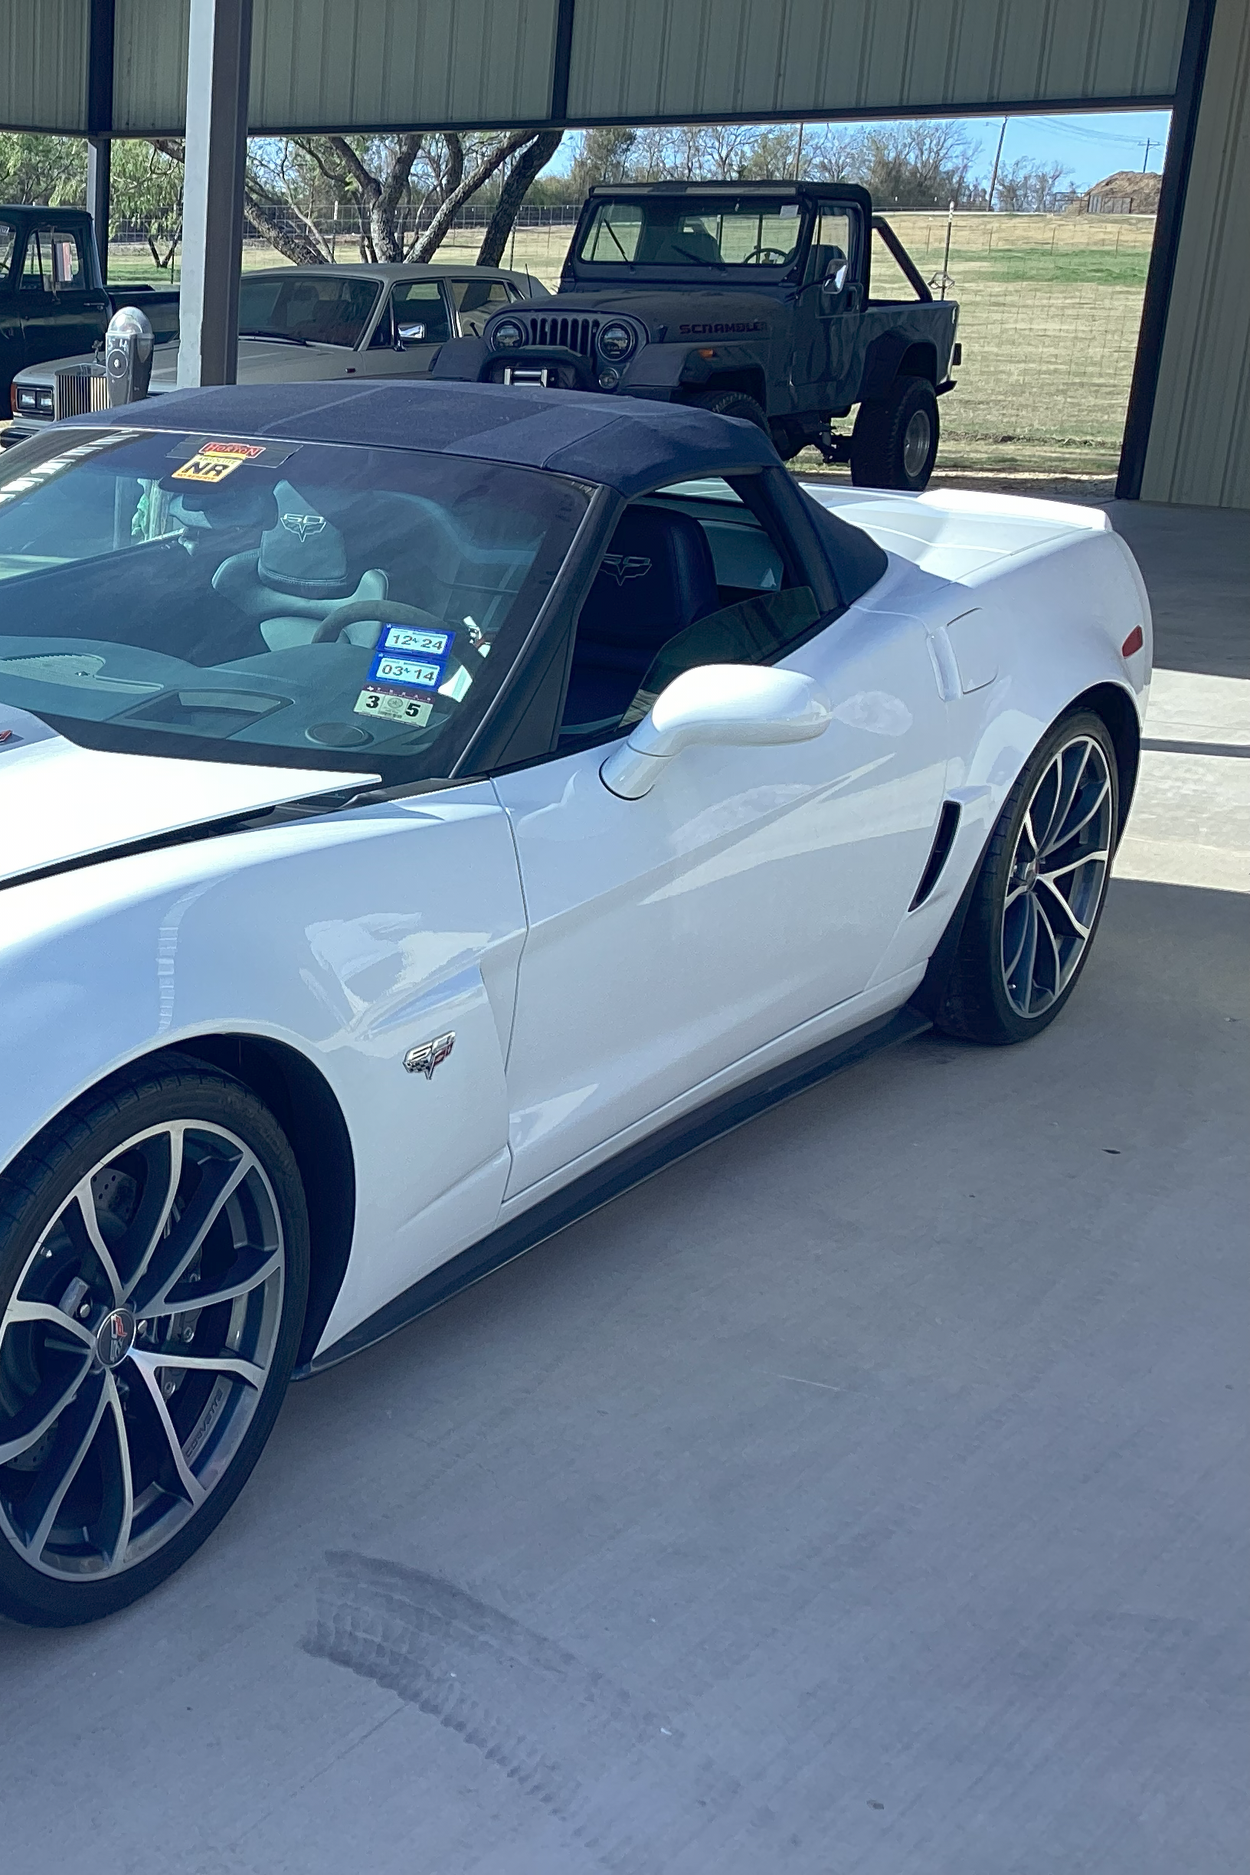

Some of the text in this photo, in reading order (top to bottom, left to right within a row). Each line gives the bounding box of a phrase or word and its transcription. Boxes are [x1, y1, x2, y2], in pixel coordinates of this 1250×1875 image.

[203, 443, 260, 457] HORTON
[181, 461, 231, 477] NR
[393, 634, 443, 650] 12 24
[382, 664, 404, 676] 03
[414, 668, 435, 681] 14
[366, 695, 380, 708] 3
[405, 702, 421, 717] 5
